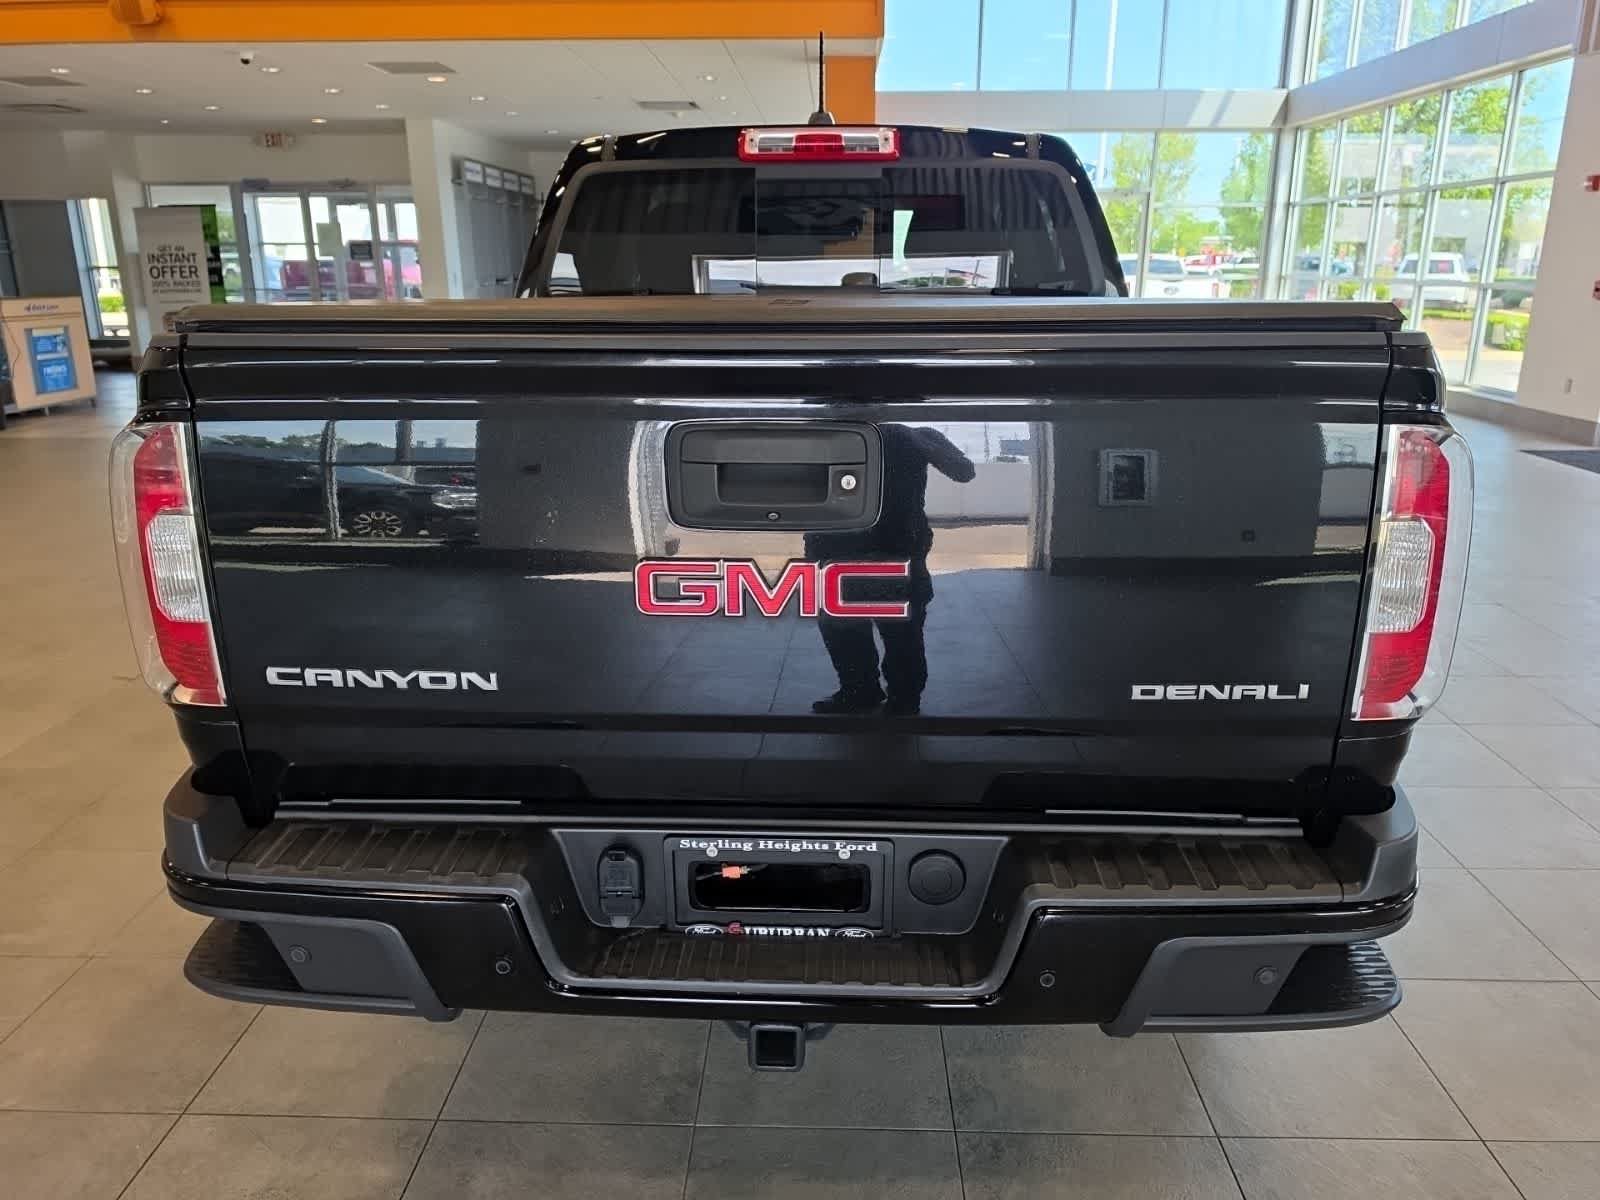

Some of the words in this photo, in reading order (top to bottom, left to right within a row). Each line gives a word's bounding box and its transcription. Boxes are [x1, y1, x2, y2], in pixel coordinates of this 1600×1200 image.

[147, 252, 198, 265] INSTANT
[149, 265, 200, 279] OFFER
[634, 560, 911, 618] GMC
[265, 666, 498, 691] CANYON
[1131, 684, 1310, 700] DENALI
[679, 839, 754, 851] Sterling
[758, 840, 830, 851] Heights
[834, 841, 878, 852] Ford
